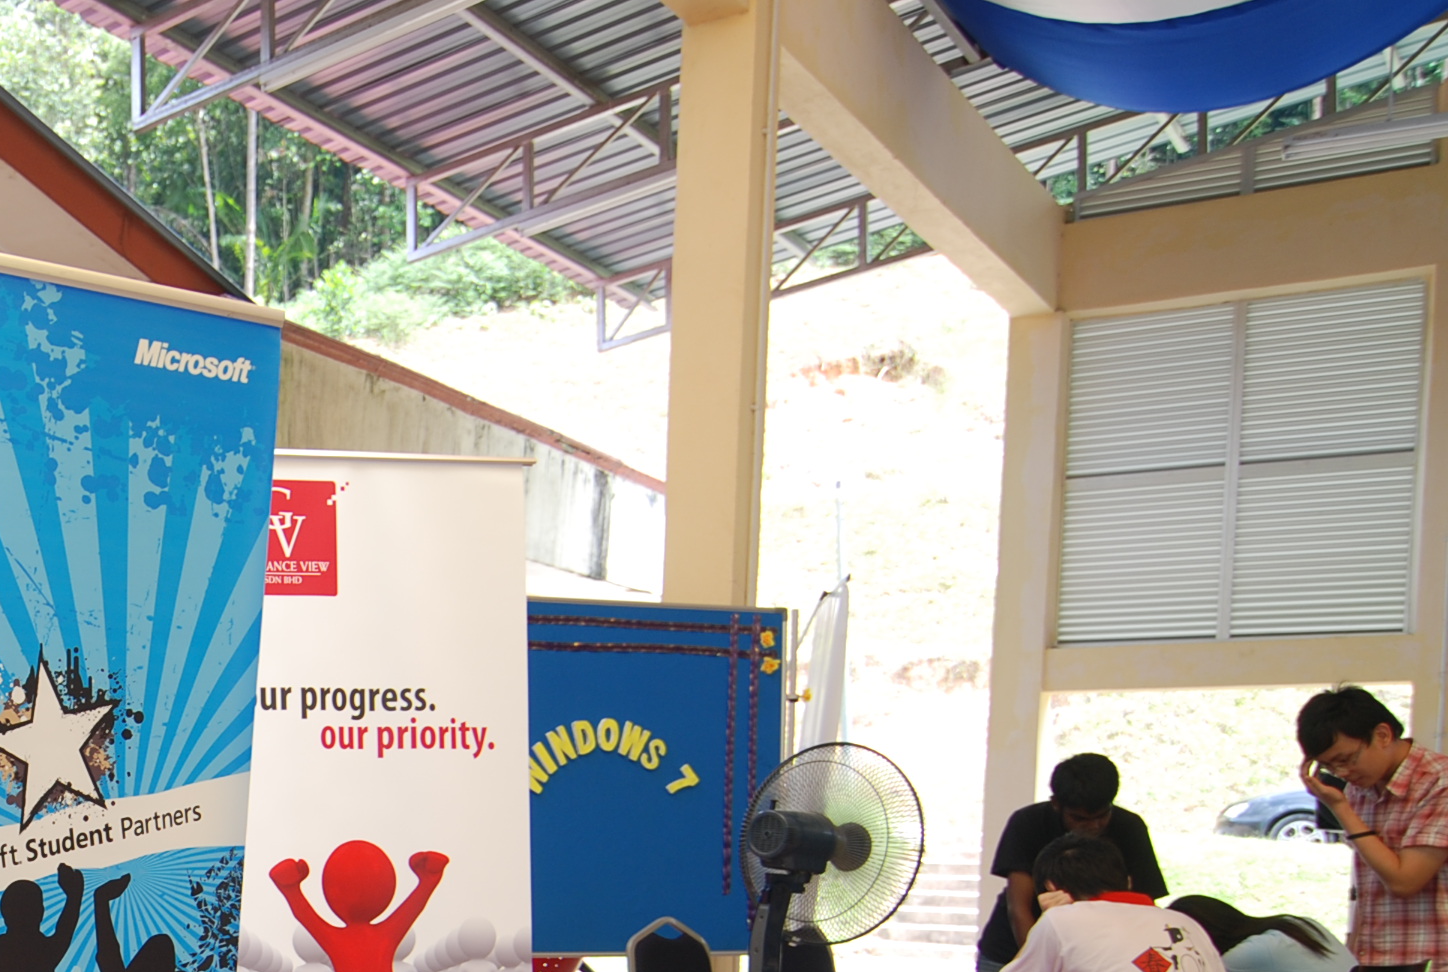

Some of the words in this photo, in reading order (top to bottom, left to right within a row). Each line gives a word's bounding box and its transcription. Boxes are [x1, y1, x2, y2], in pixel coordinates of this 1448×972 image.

[133, 337, 252, 384] Microsoft
[265, 560, 298, 572] ANCE
[299, 561, 331, 573] VIEW
[283, 575, 304, 585] BHD
[259, 686, 293, 711] ur
[300, 687, 436, 721] progress.
[320, 725, 369, 750] our
[377, 717, 495, 759] priority.
[665, 763, 701, 795] 7
[25, 821, 114, 862] Student
[121, 804, 202, 840] Partners
